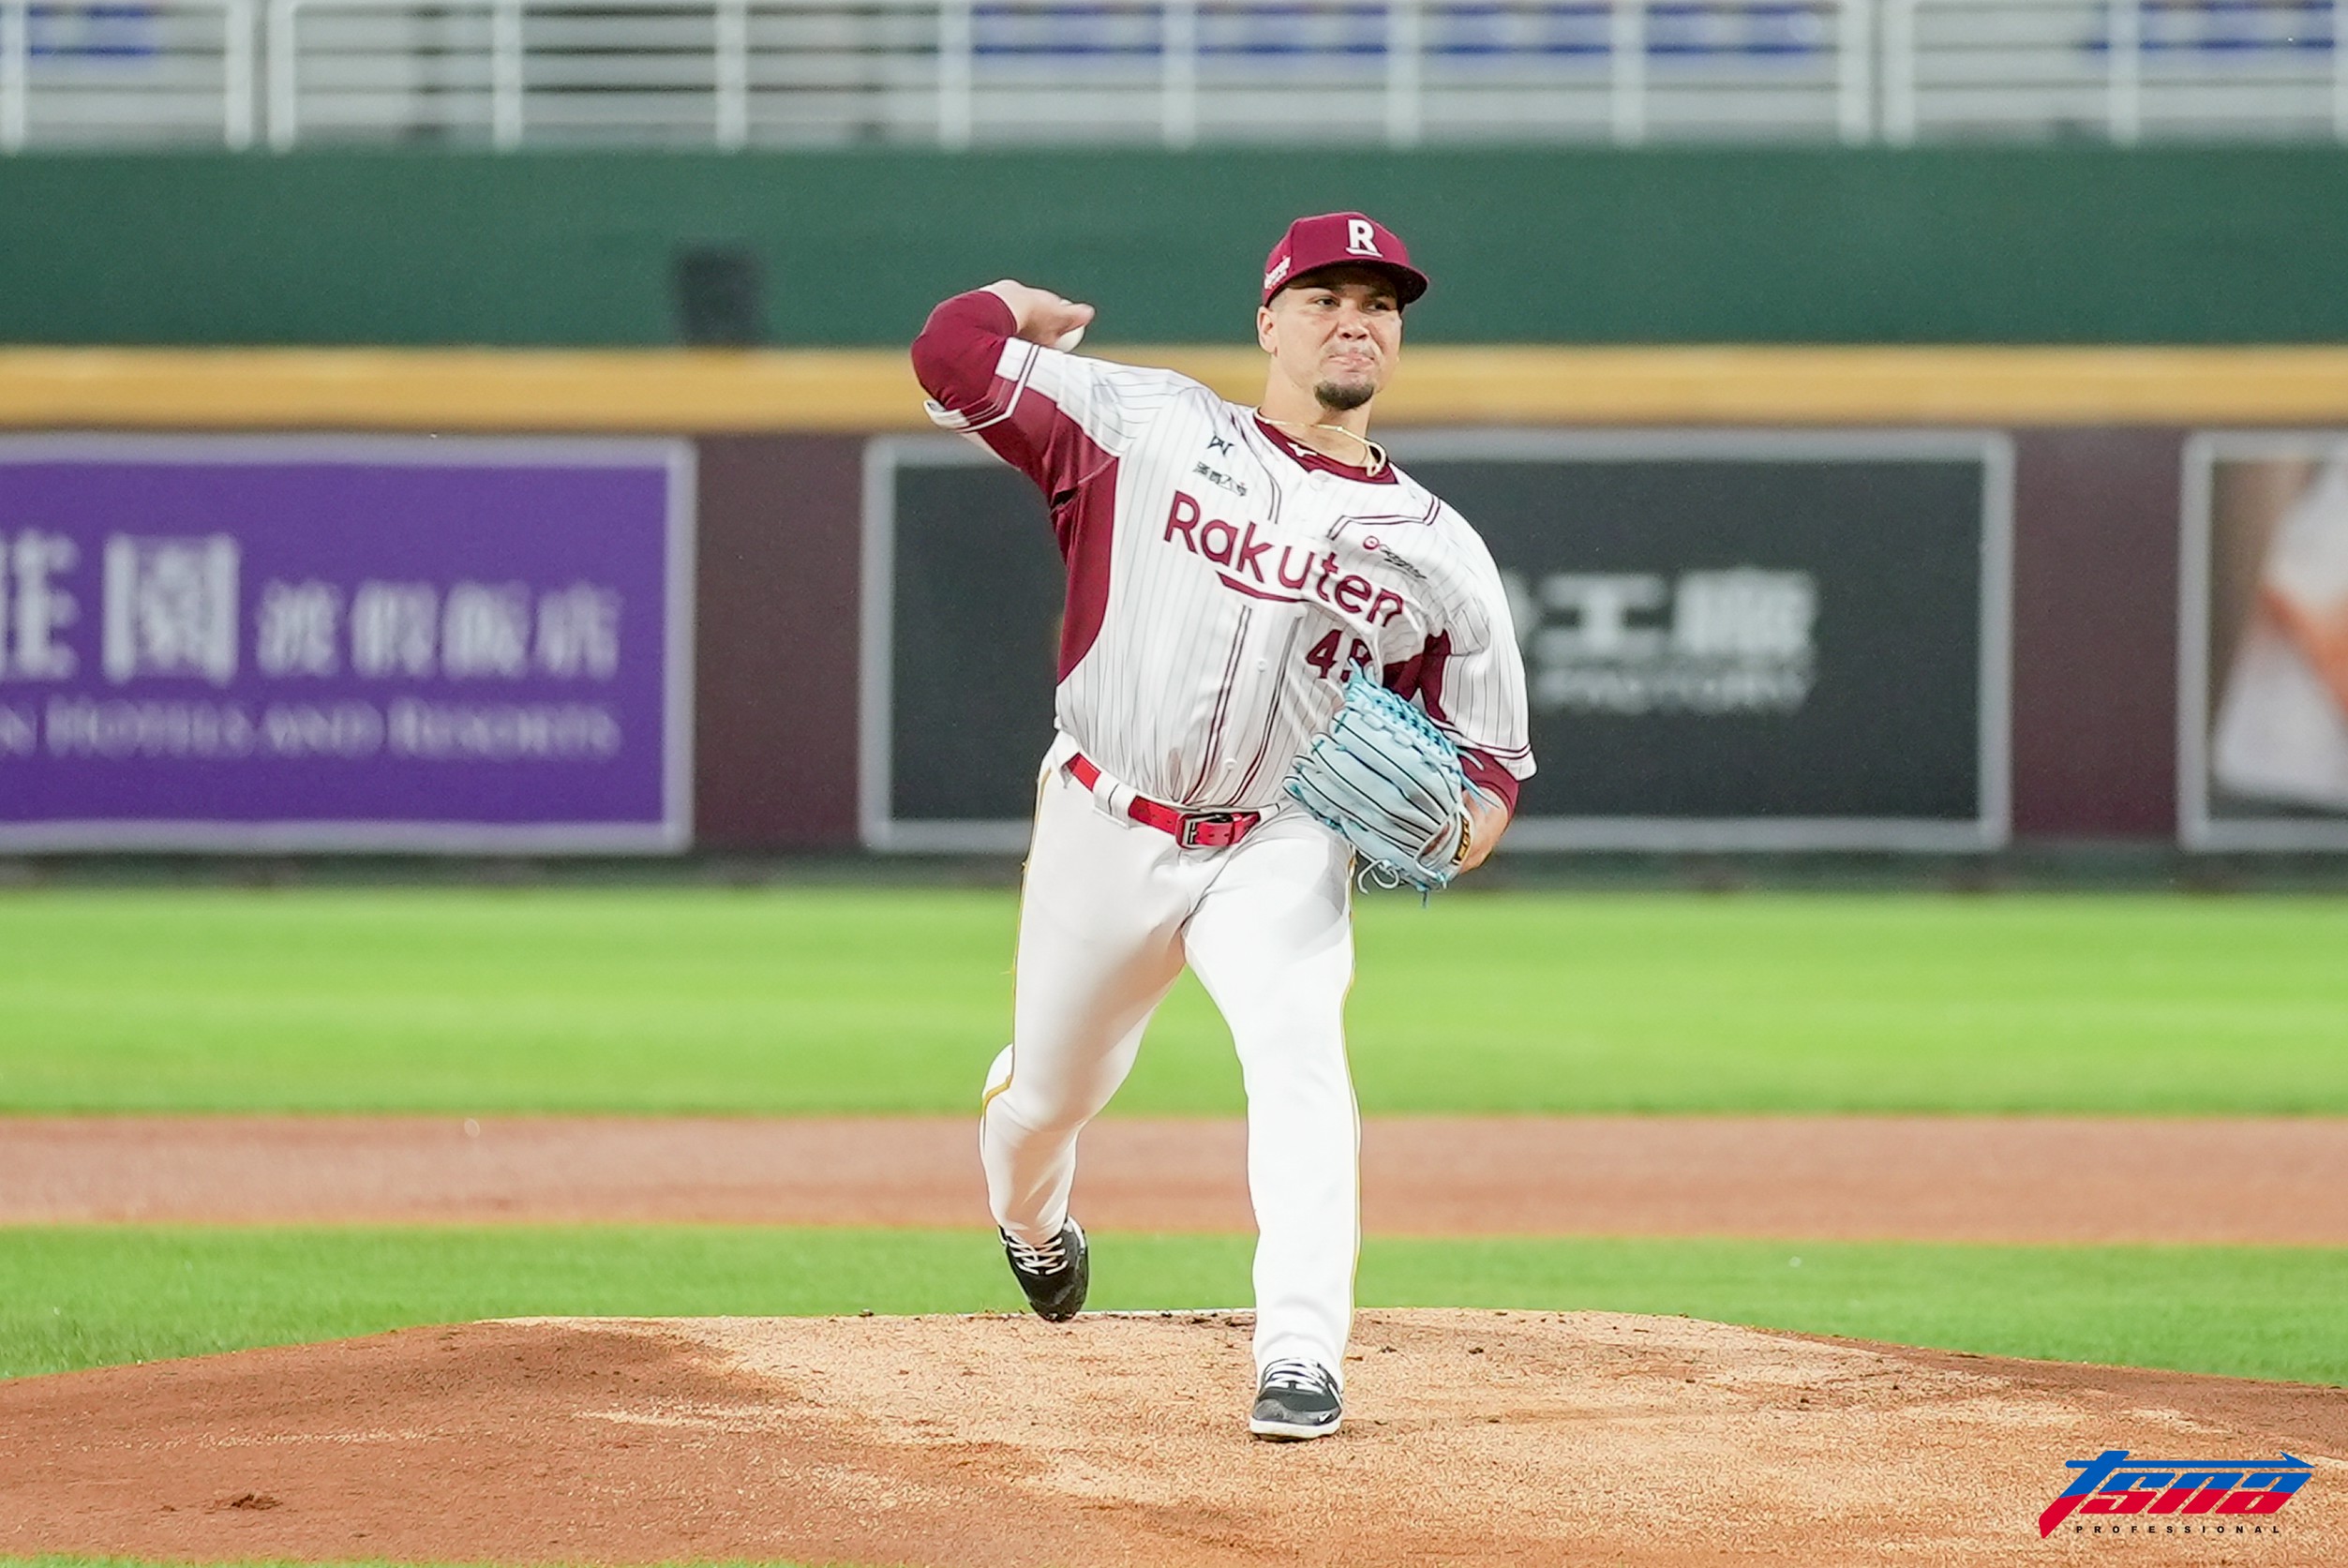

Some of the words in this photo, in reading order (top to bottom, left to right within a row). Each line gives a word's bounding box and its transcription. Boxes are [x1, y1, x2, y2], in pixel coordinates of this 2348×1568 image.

[1347, 218, 1380, 257] R
[1164, 490, 1403, 627] Rakuten
[1502, 568, 1817, 660] 工廠
